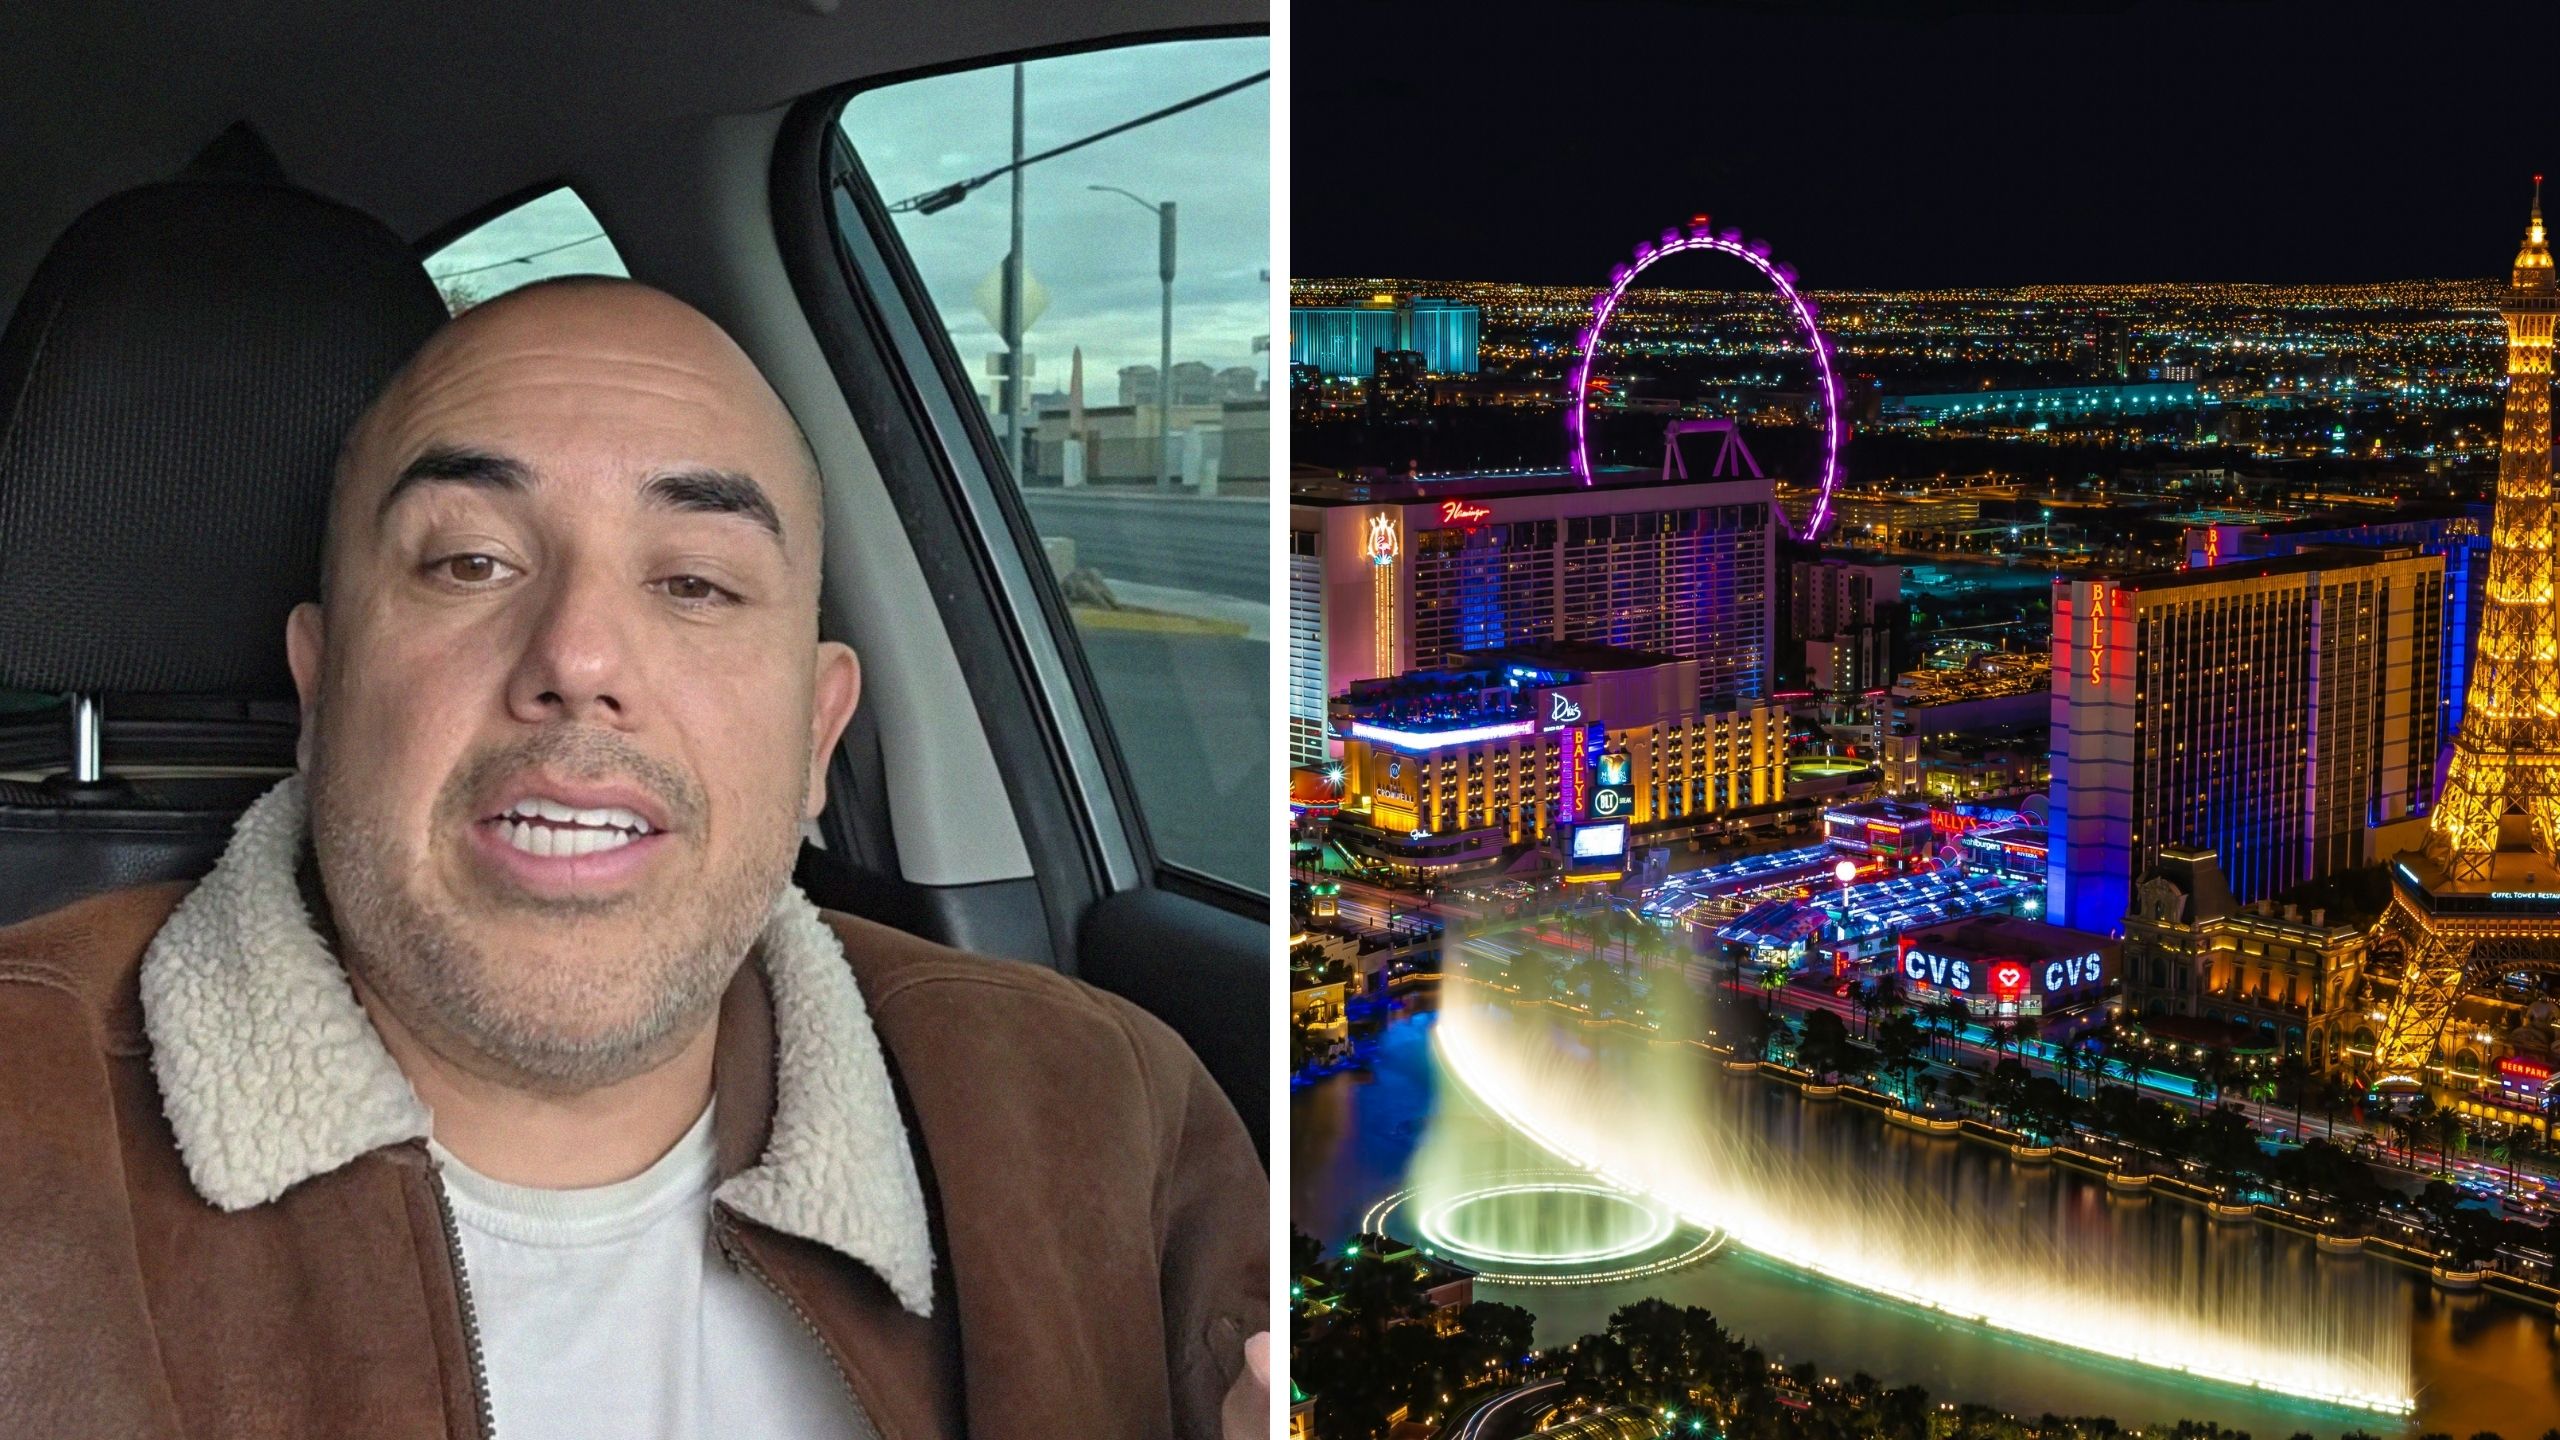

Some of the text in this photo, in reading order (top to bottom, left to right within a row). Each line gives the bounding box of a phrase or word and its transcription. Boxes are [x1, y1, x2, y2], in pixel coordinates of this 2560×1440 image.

[2090, 584, 2105, 684] BALLYS
[1574, 731, 1585, 811] BALLYS
[1931, 810, 1977, 831] BALLY'S
[1905, 950, 1971, 991] CVS
[2045, 952, 2101, 991] CVS
[2502, 1061, 2548, 1079] BEER PARK
